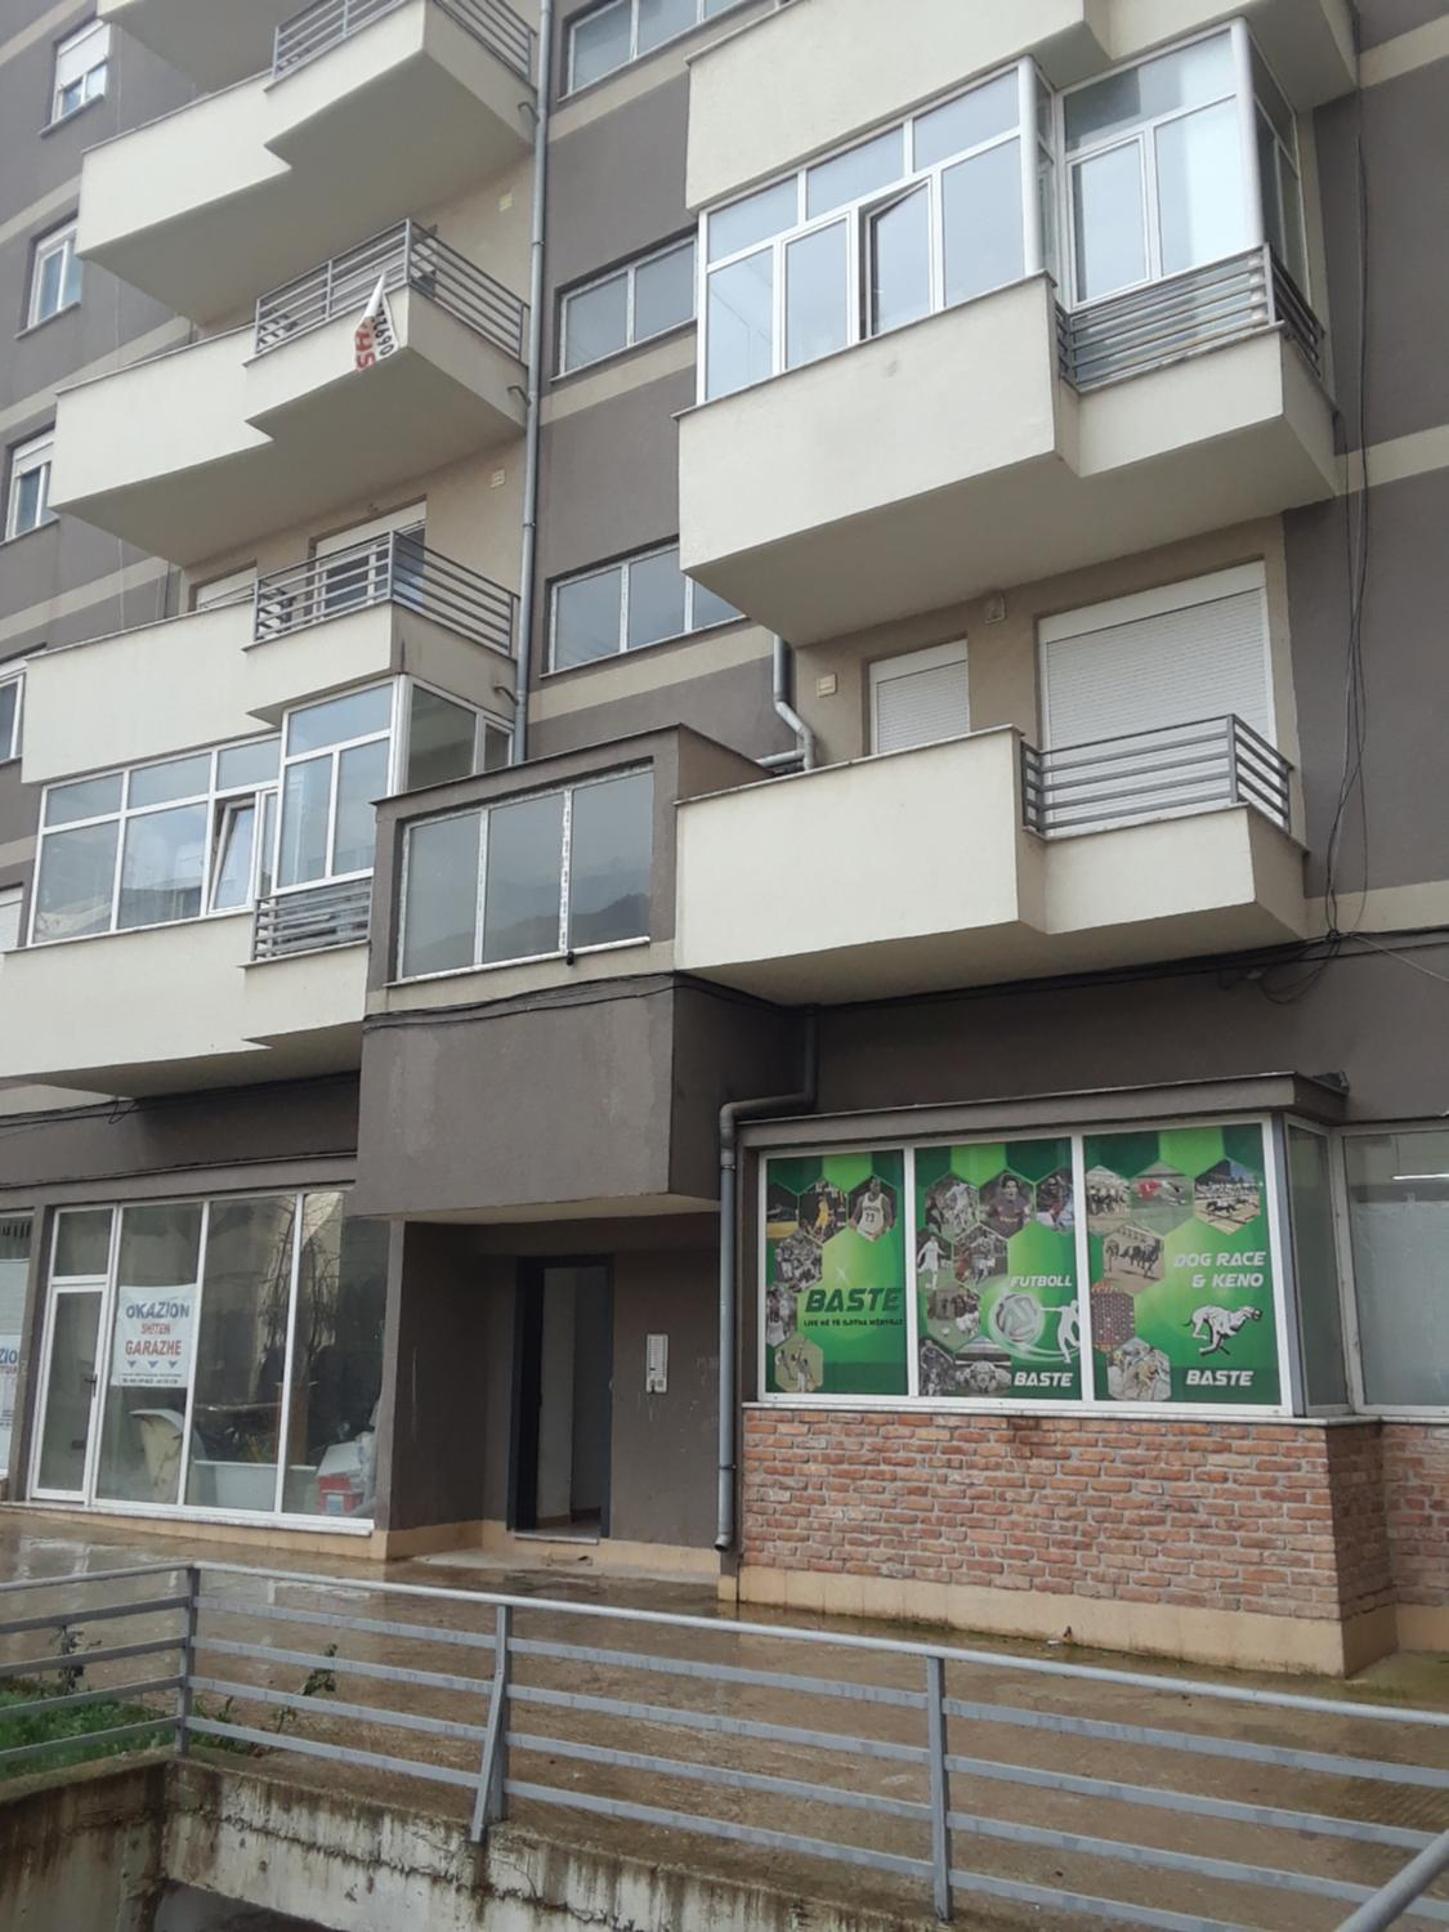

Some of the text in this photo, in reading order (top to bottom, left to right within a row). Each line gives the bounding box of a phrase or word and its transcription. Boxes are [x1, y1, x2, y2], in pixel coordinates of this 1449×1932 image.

[1175, 1251, 1266, 1268] DOG RACE
[1009, 1275, 1073, 1288] FUTBOLL
[1192, 1272, 1264, 1288] & KENO
[805, 1287, 903, 1313] BASTE
[126, 1302, 190, 1318] OKAZION
[125, 1340, 182, 1356] GARAZHE
[1013, 1372, 1073, 1387] BASTE
[1186, 1369, 1253, 1386] BASTE
